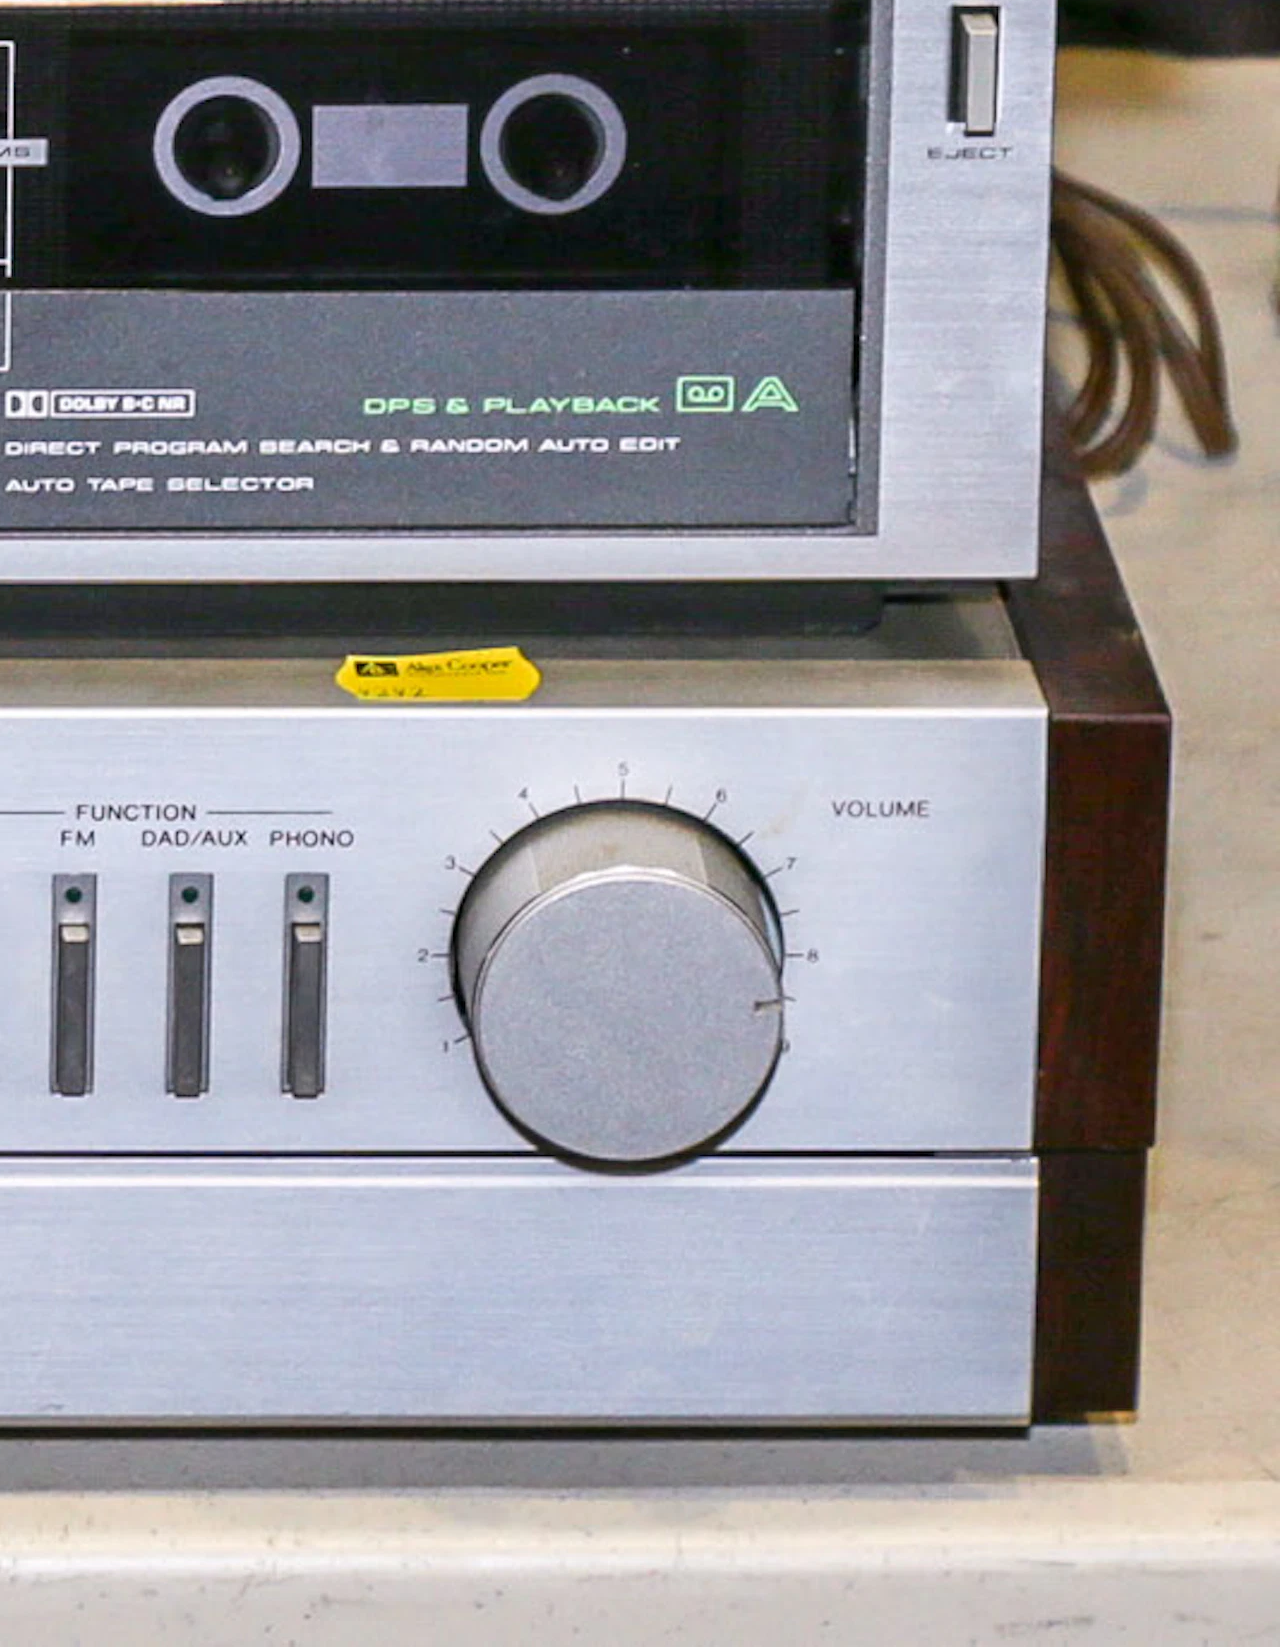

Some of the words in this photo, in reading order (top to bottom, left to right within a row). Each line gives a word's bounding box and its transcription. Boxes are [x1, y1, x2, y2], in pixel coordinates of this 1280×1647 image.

[926, 146, 1012, 161] EJECT
[59, 397, 118, 411] DOLBY
[158, 397, 185, 411] NR
[363, 397, 436, 415] DPS
[445, 397, 470, 415] &
[483, 396, 660, 414] PLAYBACK
[4, 441, 102, 456] DIRECT
[113, 440, 248, 456] PROGRAM
[259, 439, 371, 455] SEARCH
[380, 438, 400, 454] &
[410, 438, 529, 453] RANDOM
[538, 438, 610, 453] AUTO
[619, 436, 681, 452] EDIT
[5, 477, 75, 493] AUTO
[86, 477, 154, 492] TAPE
[167, 476, 314, 492] SELECTOR
[76, 804, 197, 822] FUNCTION
[832, 799, 929, 818] VOLUME
[60, 829, 95, 846] FM
[141, 829, 247, 847] DAD/AUX
[269, 830, 355, 848] PHONO
